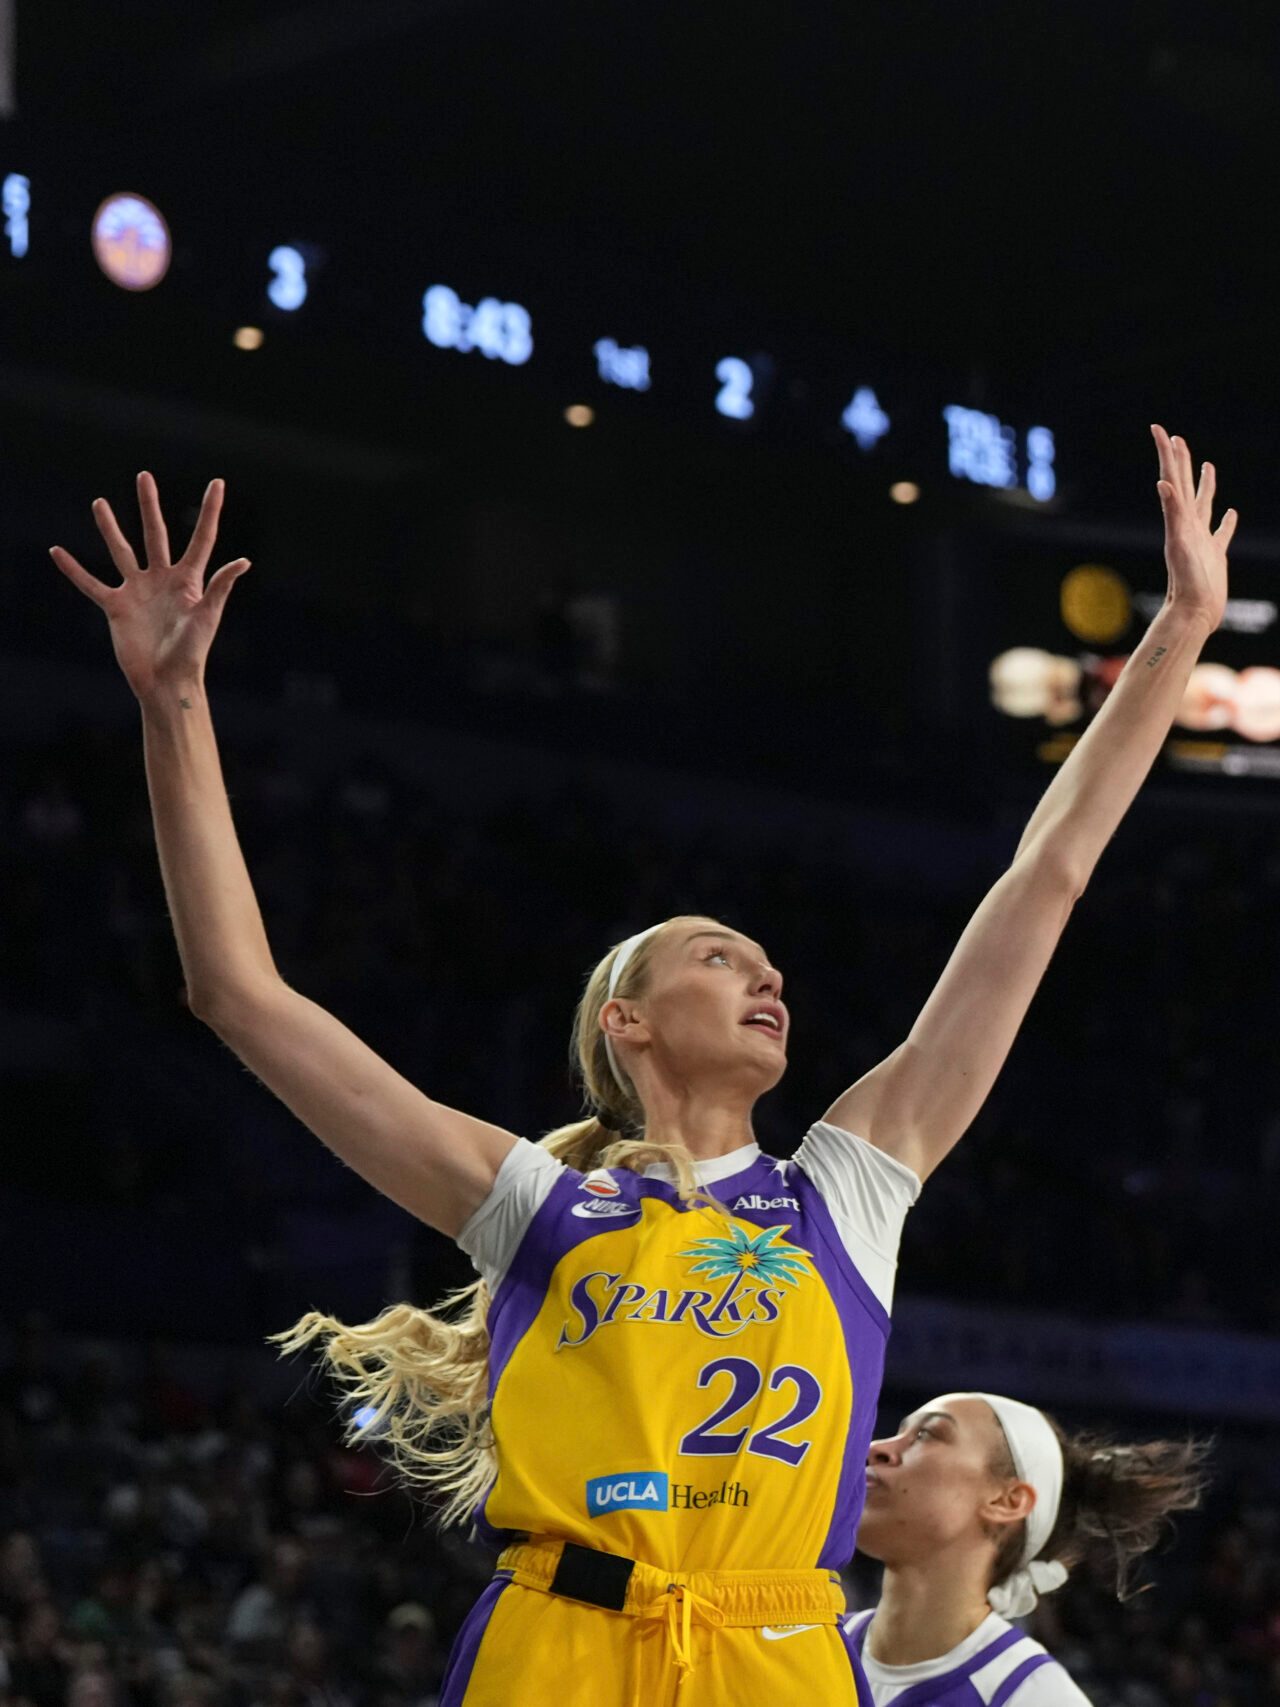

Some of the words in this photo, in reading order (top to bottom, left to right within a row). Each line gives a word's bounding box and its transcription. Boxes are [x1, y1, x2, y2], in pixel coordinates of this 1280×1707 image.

[267, 246, 308, 311] 3
[422, 284, 534, 366] 8:43
[715, 356, 754, 420] 2
[733, 1195, 800, 1212] Albert
[678, 1356, 823, 1467] 22
[596, 1481, 659, 1506] UCLA
[671, 1481, 749, 1509] Health
